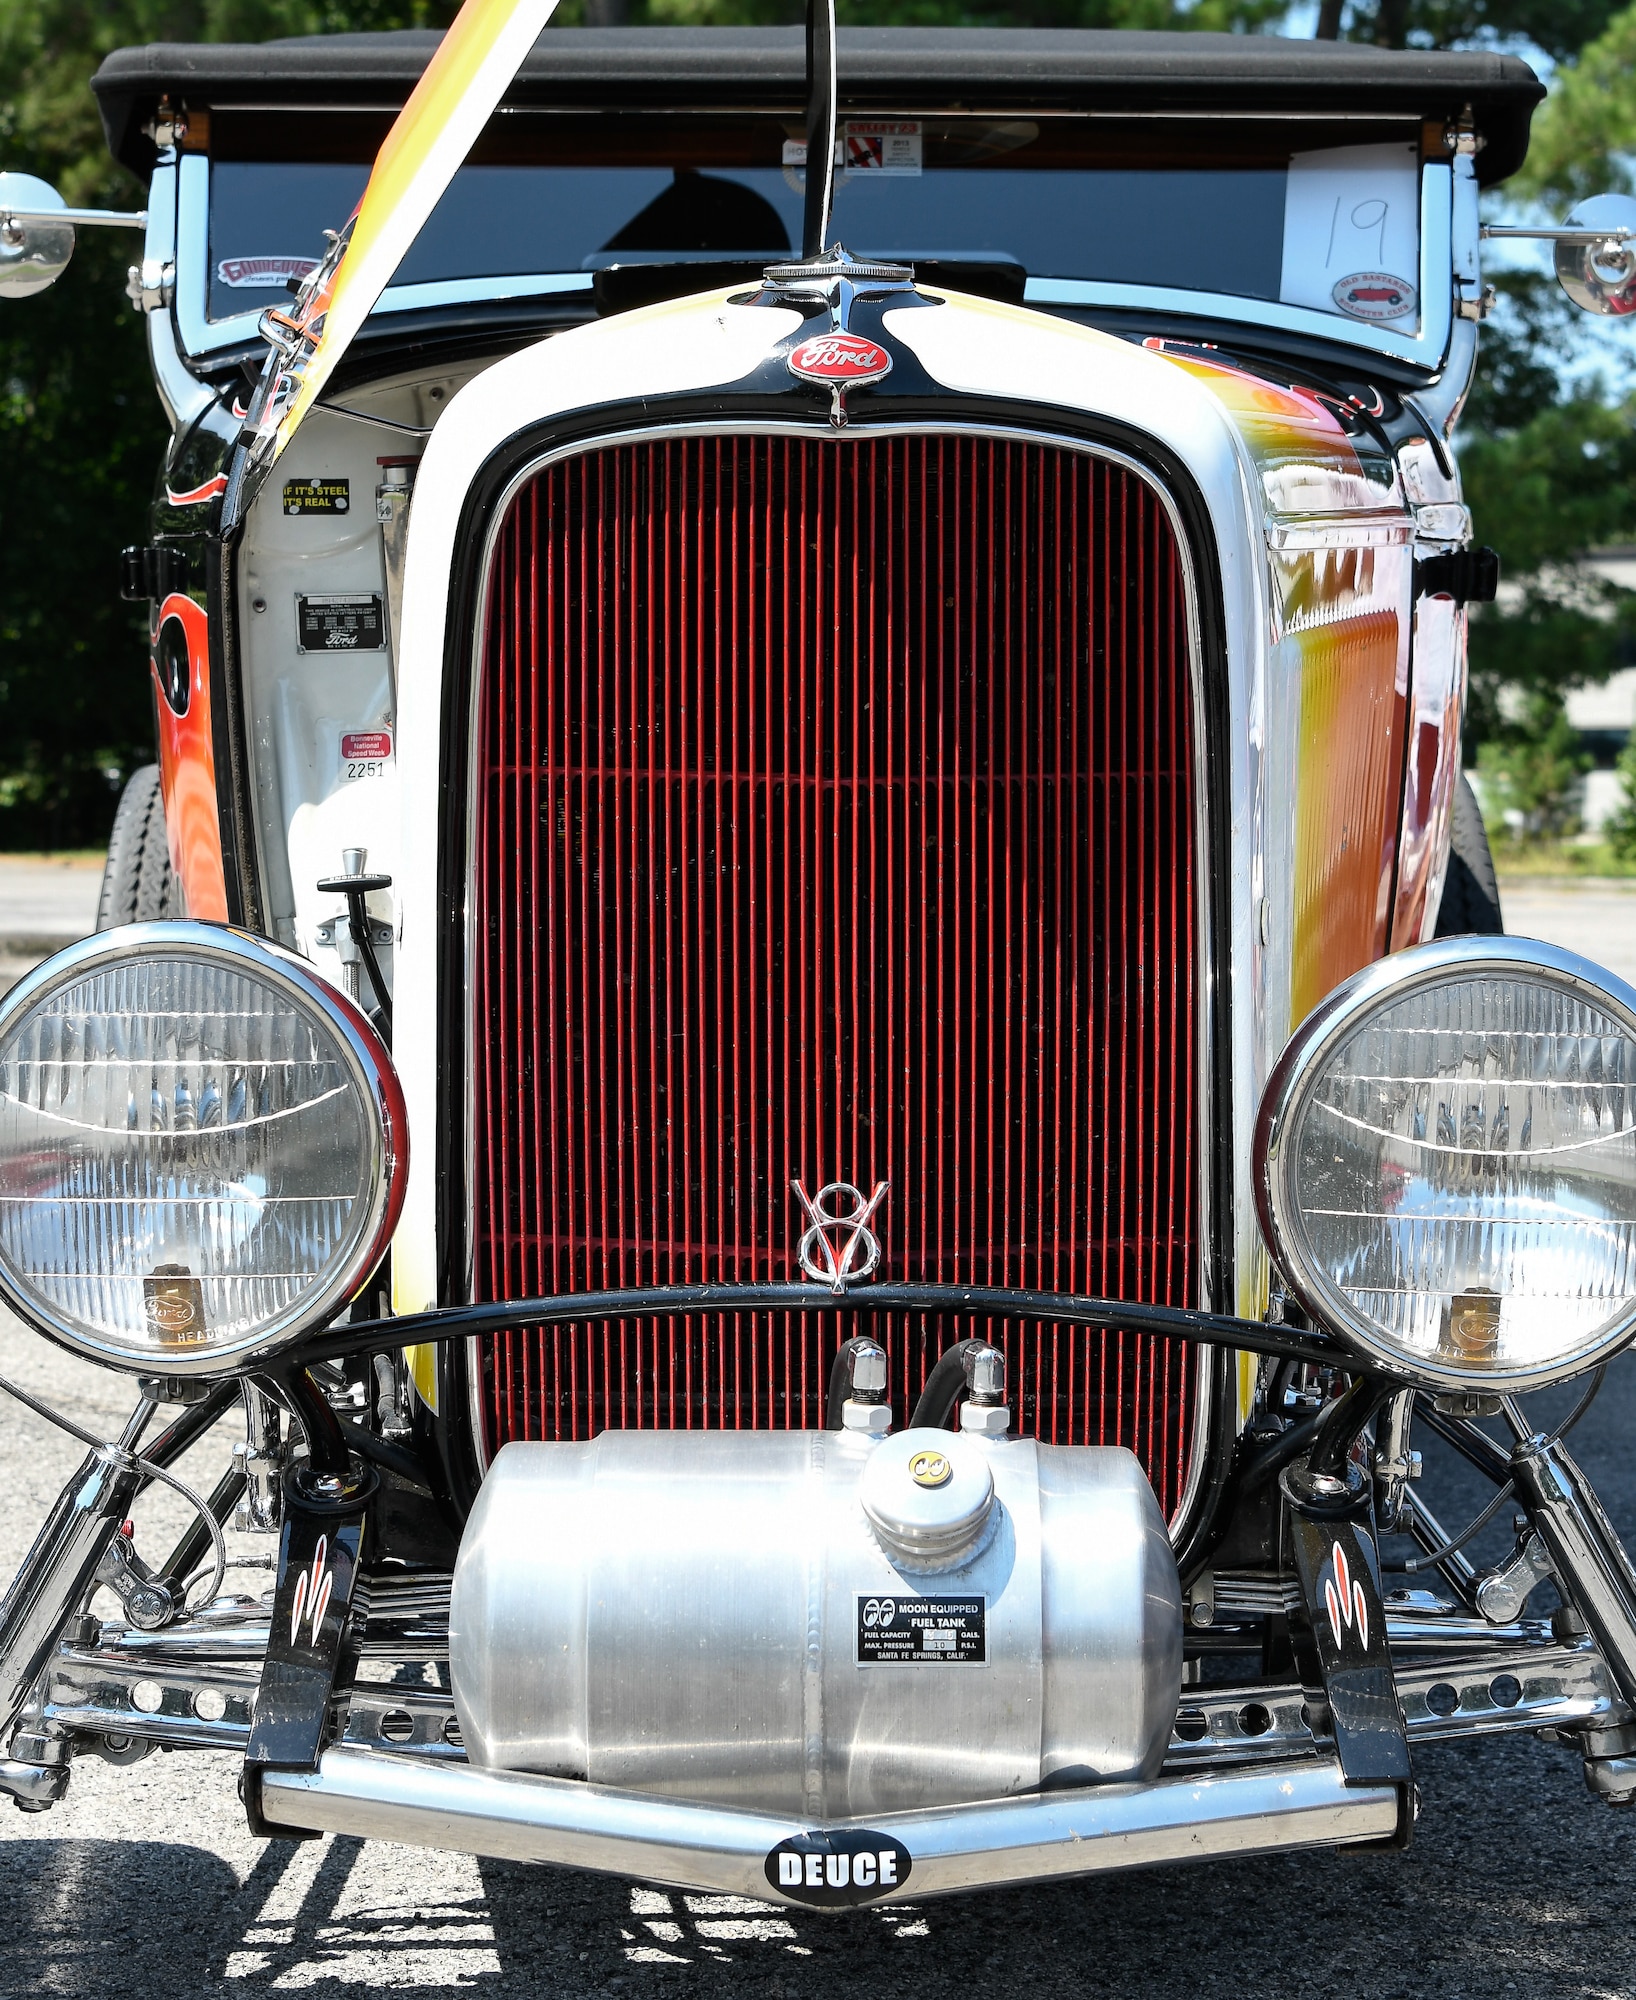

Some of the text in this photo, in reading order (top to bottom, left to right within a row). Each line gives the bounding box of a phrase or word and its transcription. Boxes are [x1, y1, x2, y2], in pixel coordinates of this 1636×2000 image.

[1325, 196, 1388, 268] 19
[1340, 275, 1411, 295] OLD BASTARDS
[1339, 298, 1409, 317] ROADSTER CLUB
[801, 338, 878, 368] Ford
[284, 486, 348, 496] IF IT'S STEEL
[284, 498, 331, 506] IT'S REAL
[325, 632, 358, 644] Ford
[348, 750, 367, 758] Speed
[348, 762, 384, 778] 2251
[899, 1604, 928, 1614] MOON
[930, 1604, 978, 1614] EQUIPPED
[911, 1618, 966, 1628] FUEL TANK
[912, 1652, 944, 1660] SPRINGS,
[778, 1850, 898, 1888] DEUCE
